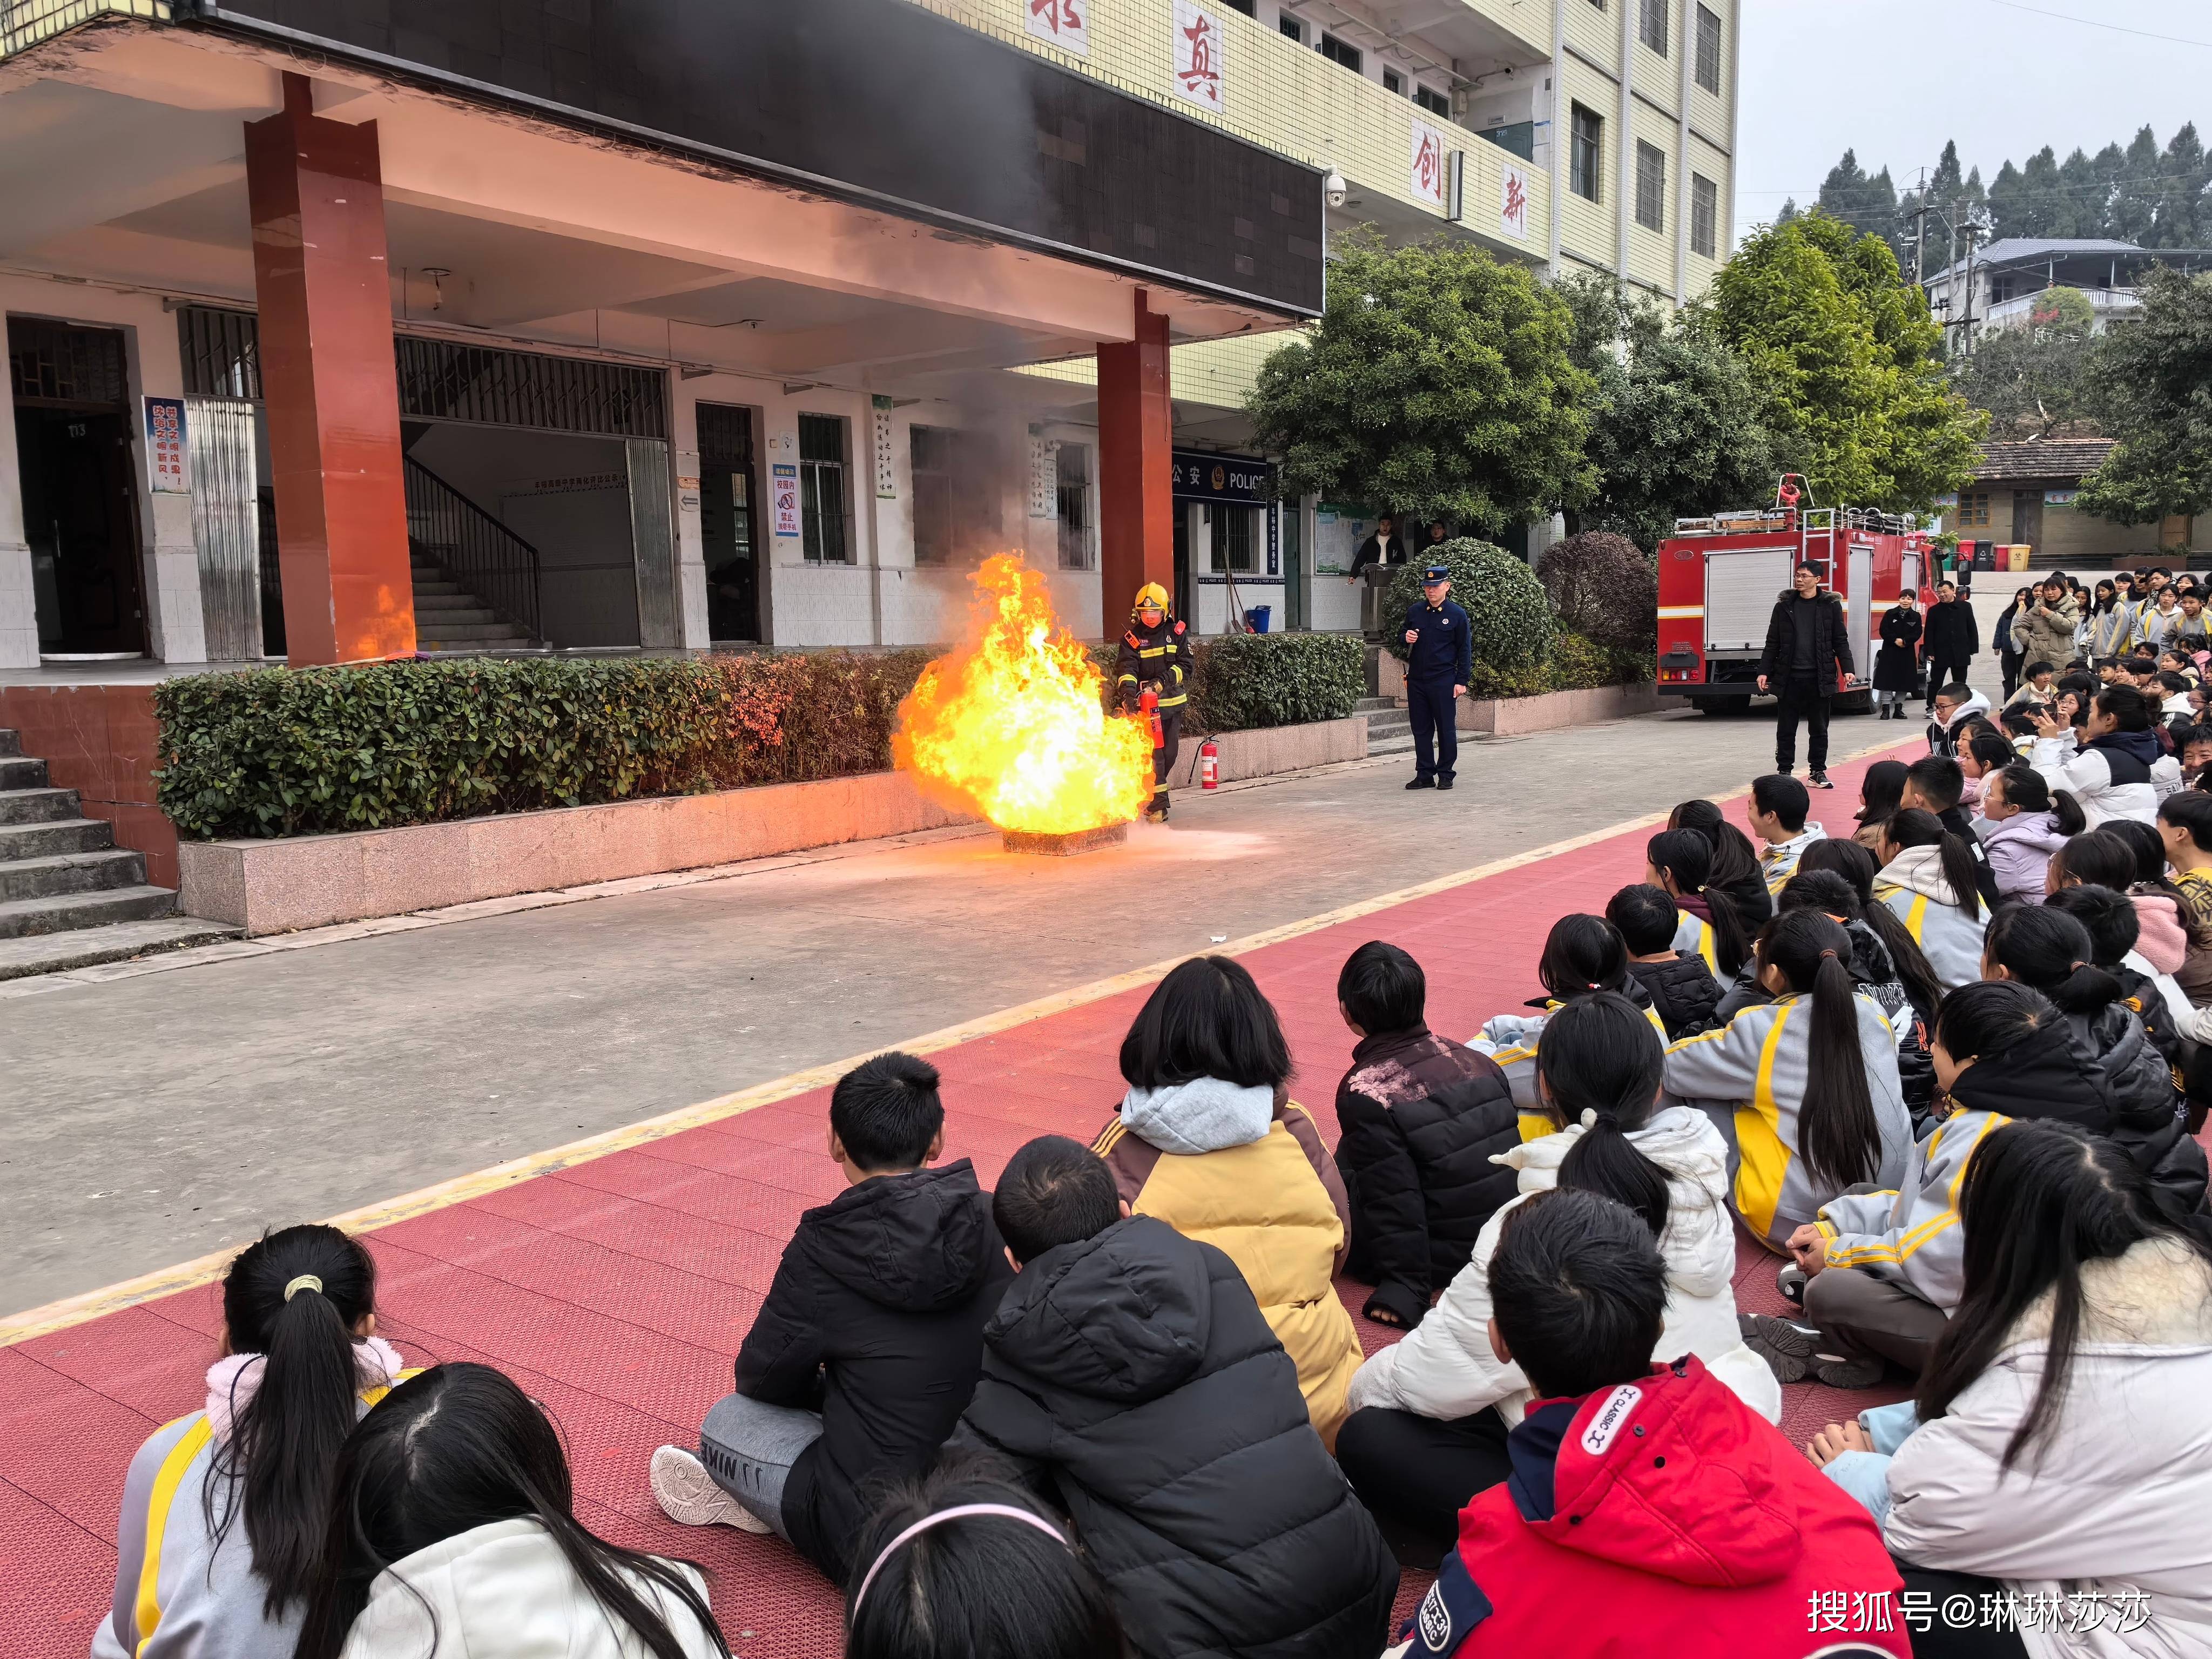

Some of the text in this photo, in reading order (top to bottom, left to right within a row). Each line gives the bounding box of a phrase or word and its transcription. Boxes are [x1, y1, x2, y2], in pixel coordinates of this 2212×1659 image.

[1178, 14, 1525, 234] 真 创 新
[777, 480, 794, 489] 校园内
[1172, 464, 1201, 485] 公安
[781, 512, 793, 522] 禁止
[1600, 1399, 1626, 1430] CLASSIC
